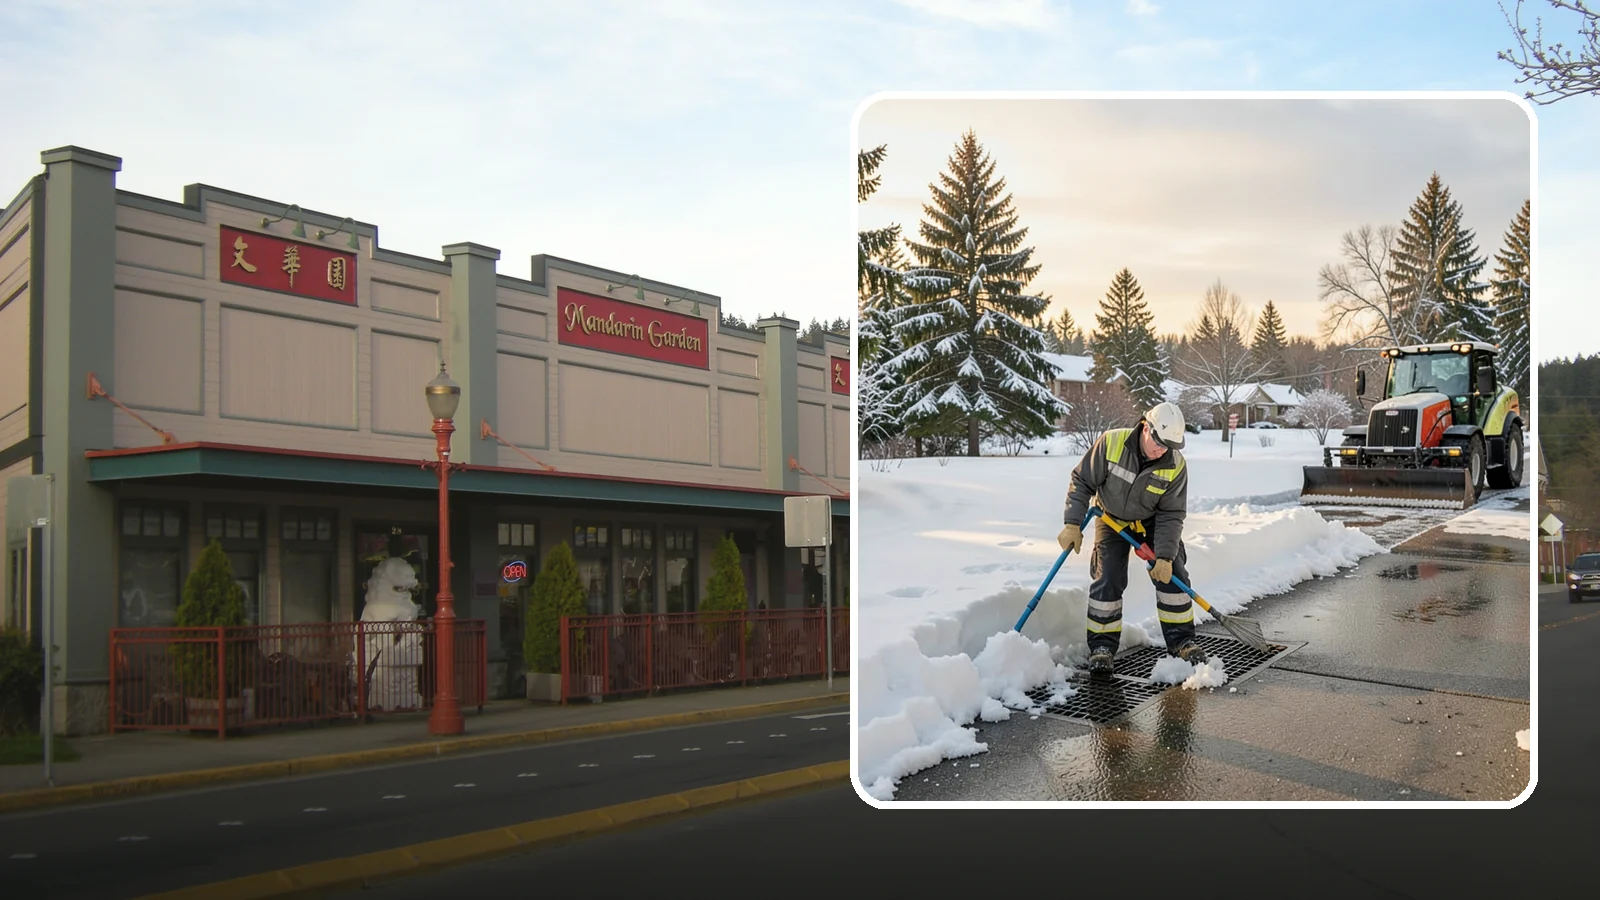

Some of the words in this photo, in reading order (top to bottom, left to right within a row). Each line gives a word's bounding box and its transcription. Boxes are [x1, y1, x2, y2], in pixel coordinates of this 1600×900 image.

[230, 235, 346, 291] 文華園
[564, 302, 644, 341] Mandarin
[647, 320, 702, 352] Garden
[503, 565, 527, 578] OPEN
